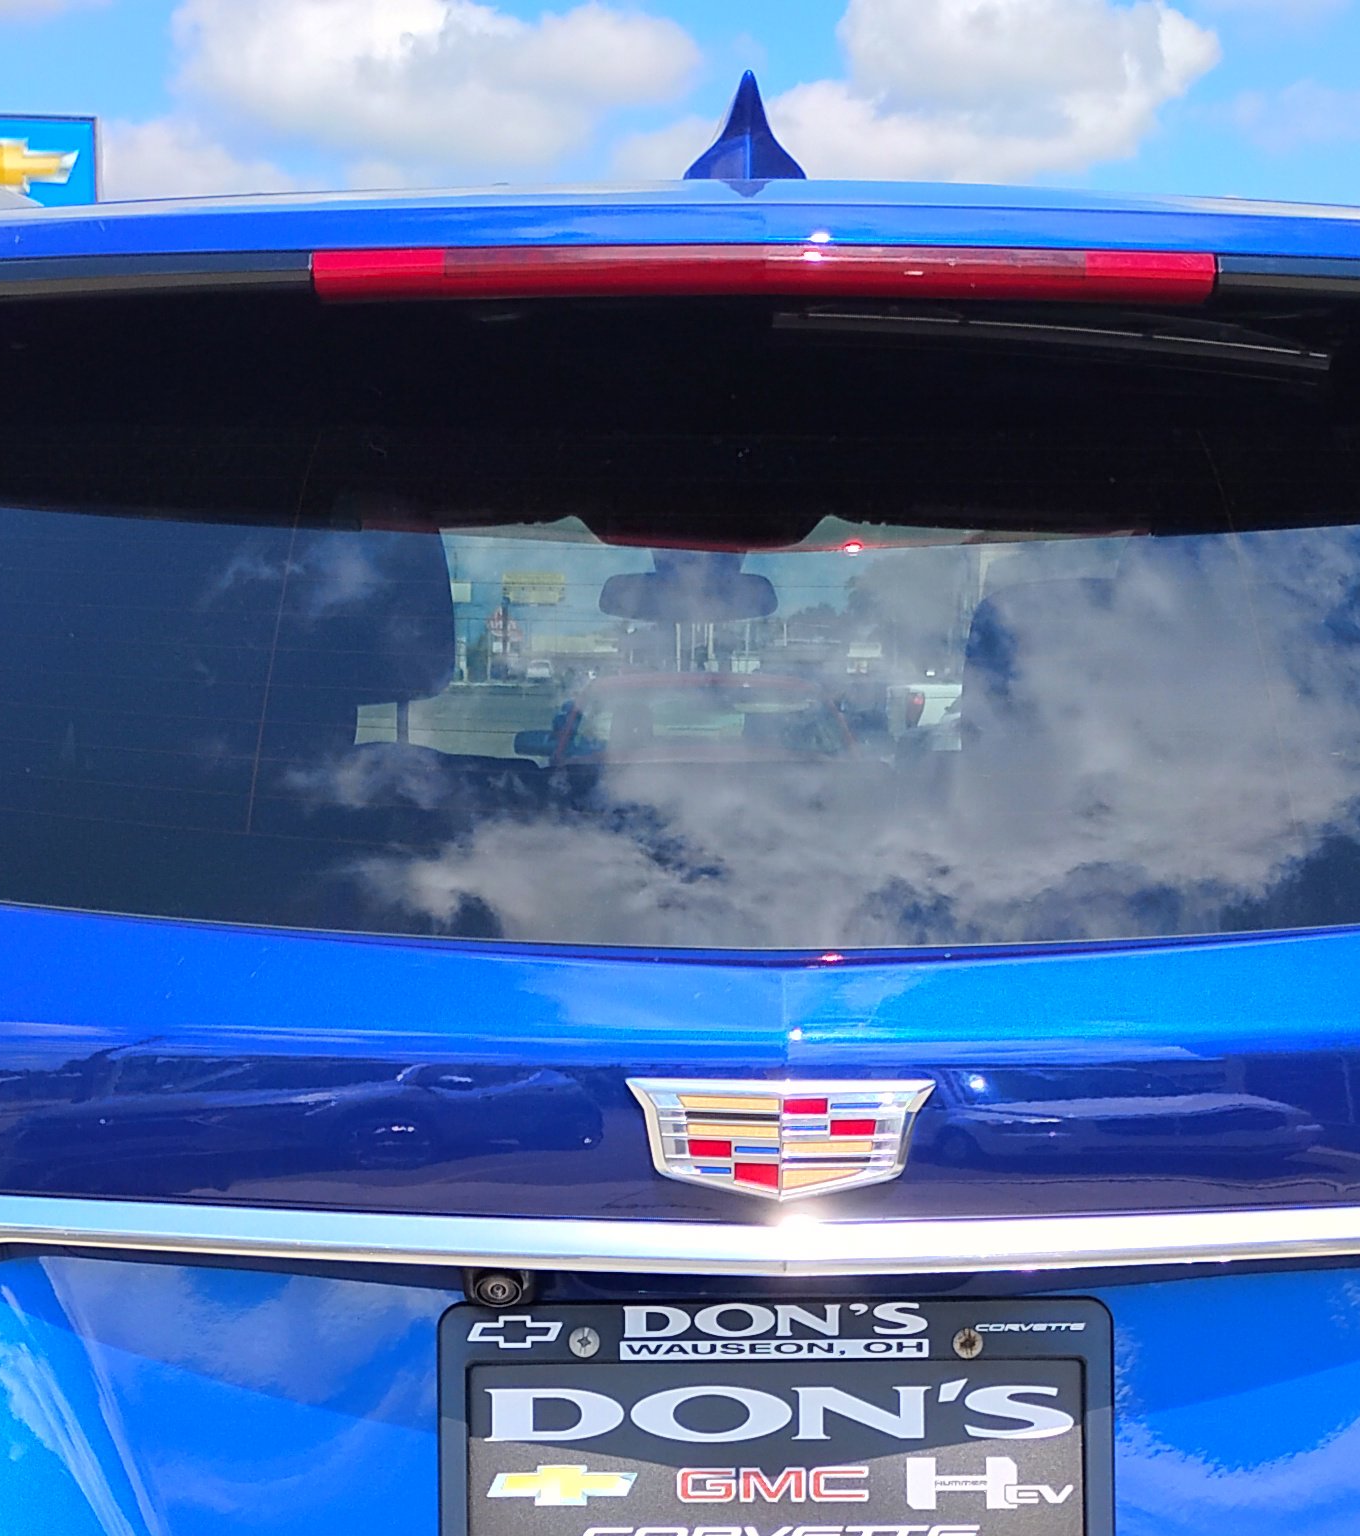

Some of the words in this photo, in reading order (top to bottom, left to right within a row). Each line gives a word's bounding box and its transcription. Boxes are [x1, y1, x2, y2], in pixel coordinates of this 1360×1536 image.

[622, 1302, 929, 1338] DON'S
[975, 1322, 1086, 1332] CORVETTE
[626, 1341, 846, 1356] WAUSEON,
[863, 1341, 924, 1353] OH
[483, 1378, 1075, 1443] DON'S
[676, 1466, 870, 1503] GMC
